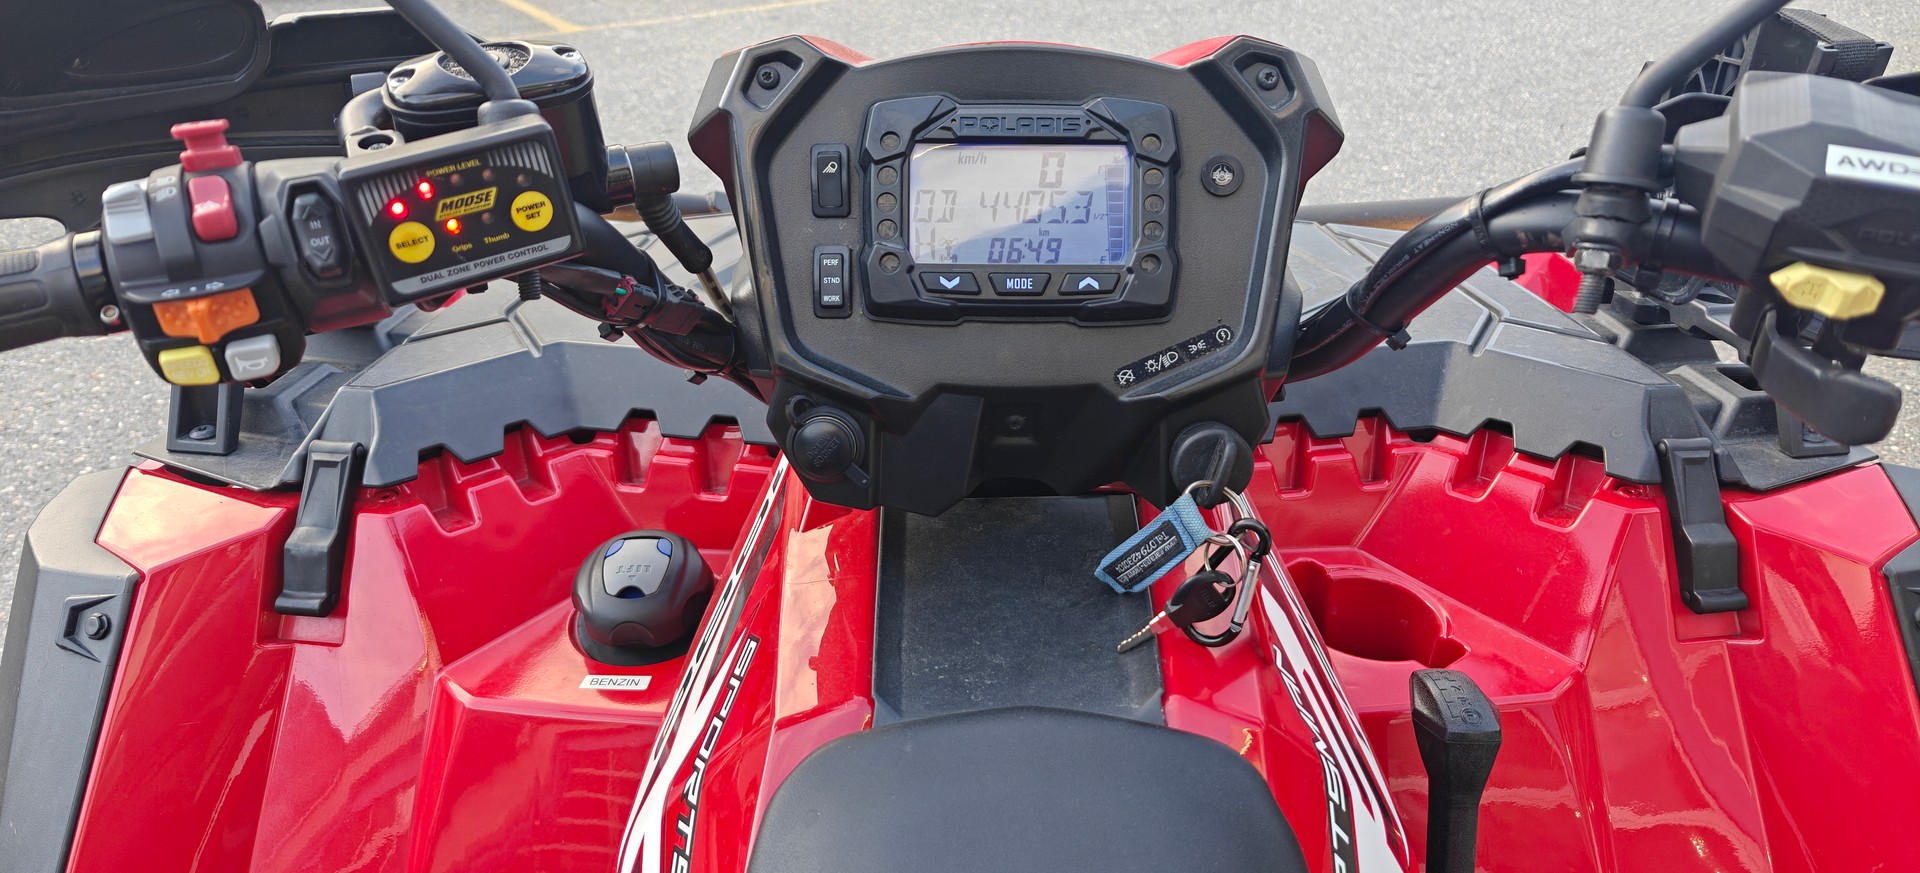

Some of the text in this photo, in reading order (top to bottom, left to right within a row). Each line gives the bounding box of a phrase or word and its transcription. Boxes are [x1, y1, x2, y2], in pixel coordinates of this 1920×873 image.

[959, 116, 1081, 133] POLARIS
[957, 152, 987, 165] km/h
[425, 158, 481, 177] POWER LEVEL
[1039, 152, 1066, 188] 0
[441, 190, 494, 213] MOOSE
[516, 201, 546, 213] POWER
[979, 190, 1094, 223] 4405.3
[526, 210, 541, 220] SET
[310, 219, 321, 230] IN
[484, 232, 510, 244] Thumb
[1038, 228, 1050, 237] km
[310, 235, 330, 247] OUT
[396, 235, 429, 249] SELECT
[452, 243, 473, 253] Grips
[987, 237, 1062, 264] 06:49
[420, 243, 549, 284] DUAL ZONE POWER CONTROL
[823, 276, 840, 284] STND
[1006, 277, 1033, 290] MODE
[616, 565, 652, 574] LIFT
[589, 677, 641, 687] BENZIN
